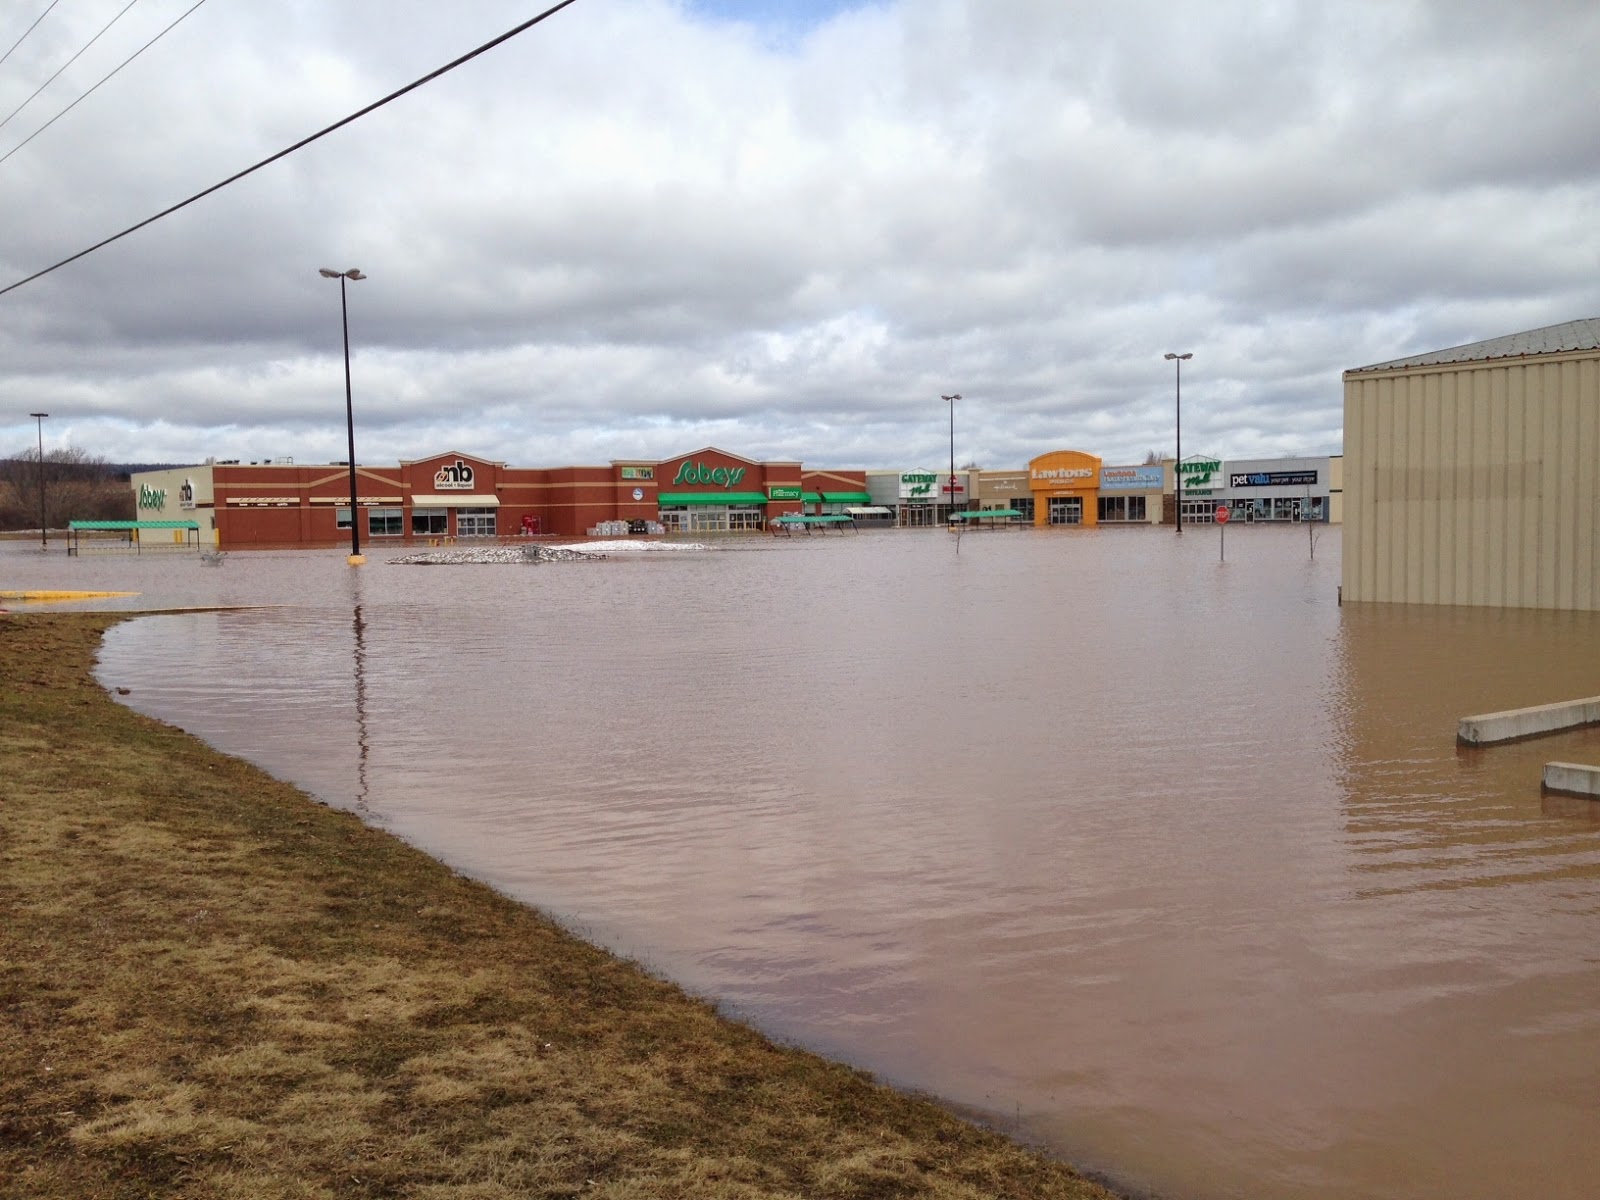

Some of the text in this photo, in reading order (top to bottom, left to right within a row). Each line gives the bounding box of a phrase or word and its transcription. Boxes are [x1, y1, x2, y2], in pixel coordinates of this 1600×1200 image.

[443, 462, 473, 482] nb
[673, 461, 745, 487] Sobeys
[1032, 468, 1092, 480] Lawtons
[1174, 461, 1221, 473] GATEWAY
[901, 474, 937, 483] GATEWAY
[1185, 473, 1211, 488] Mall
[1231, 473, 1271, 487] pet valu
[910, 484, 931, 497] Mall
[139, 483, 168, 513] Sobeys
